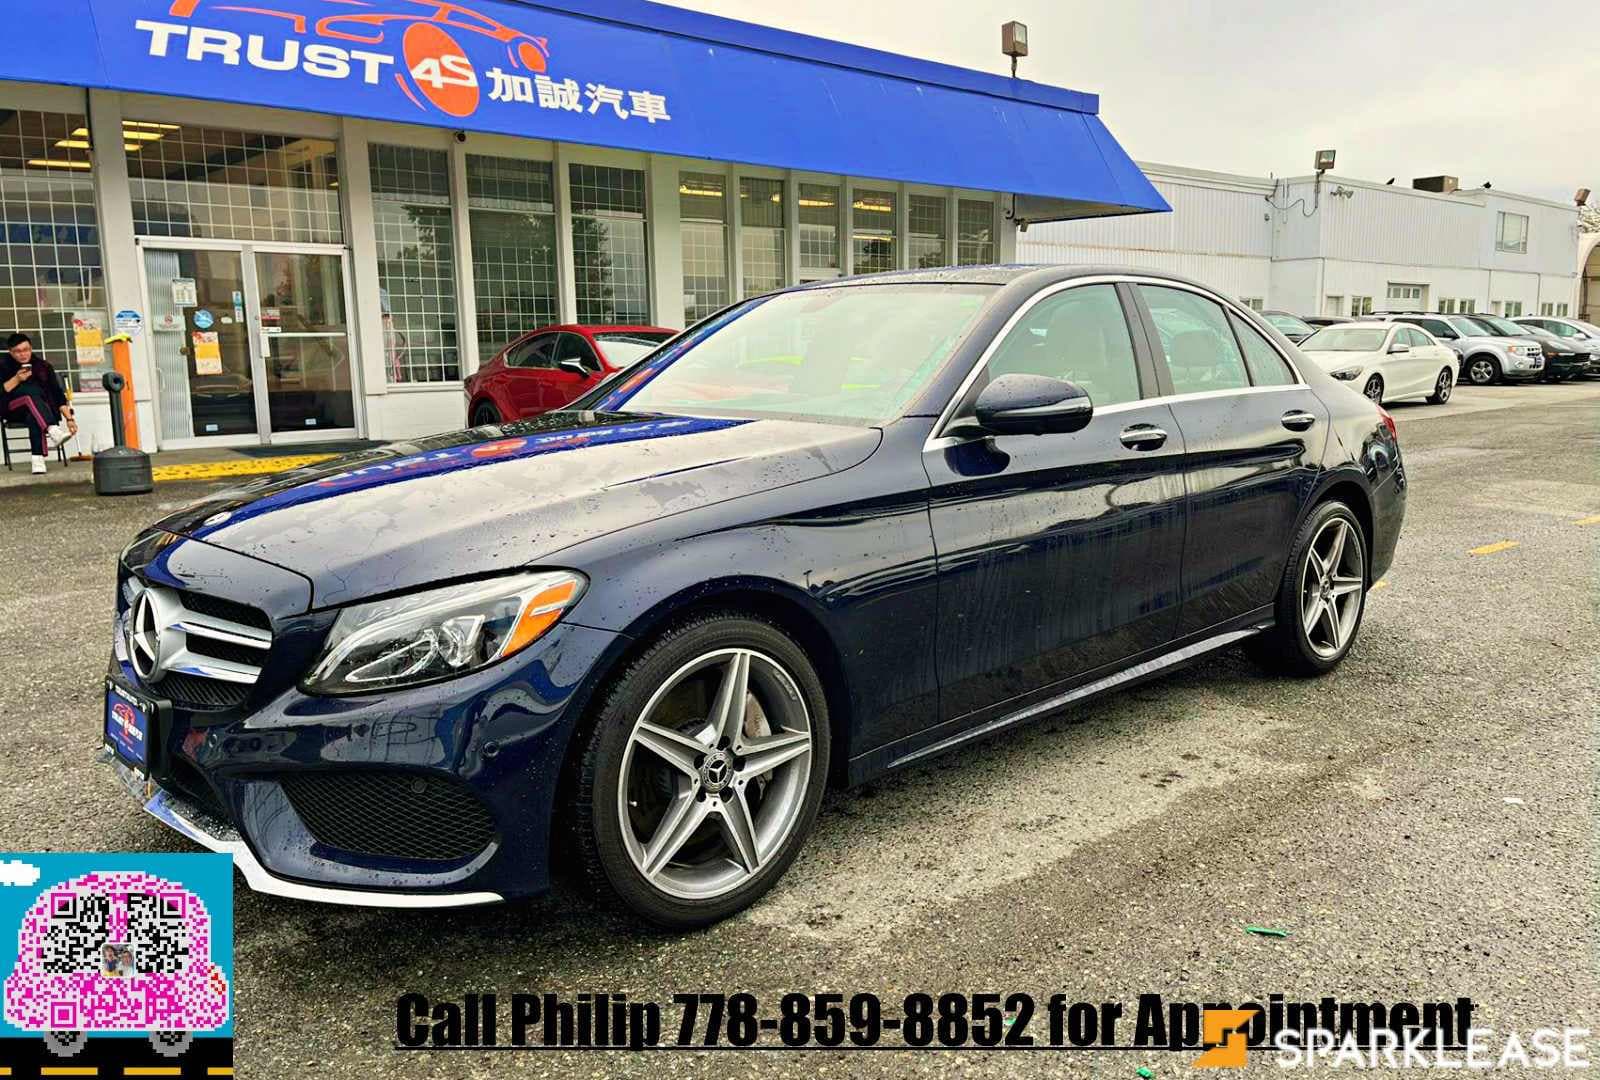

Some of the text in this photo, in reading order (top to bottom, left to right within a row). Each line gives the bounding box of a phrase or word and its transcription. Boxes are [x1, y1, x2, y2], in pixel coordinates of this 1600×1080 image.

[135, 19, 479, 89] TRUST 4S
[486, 66, 672, 124] 加誠汽車
